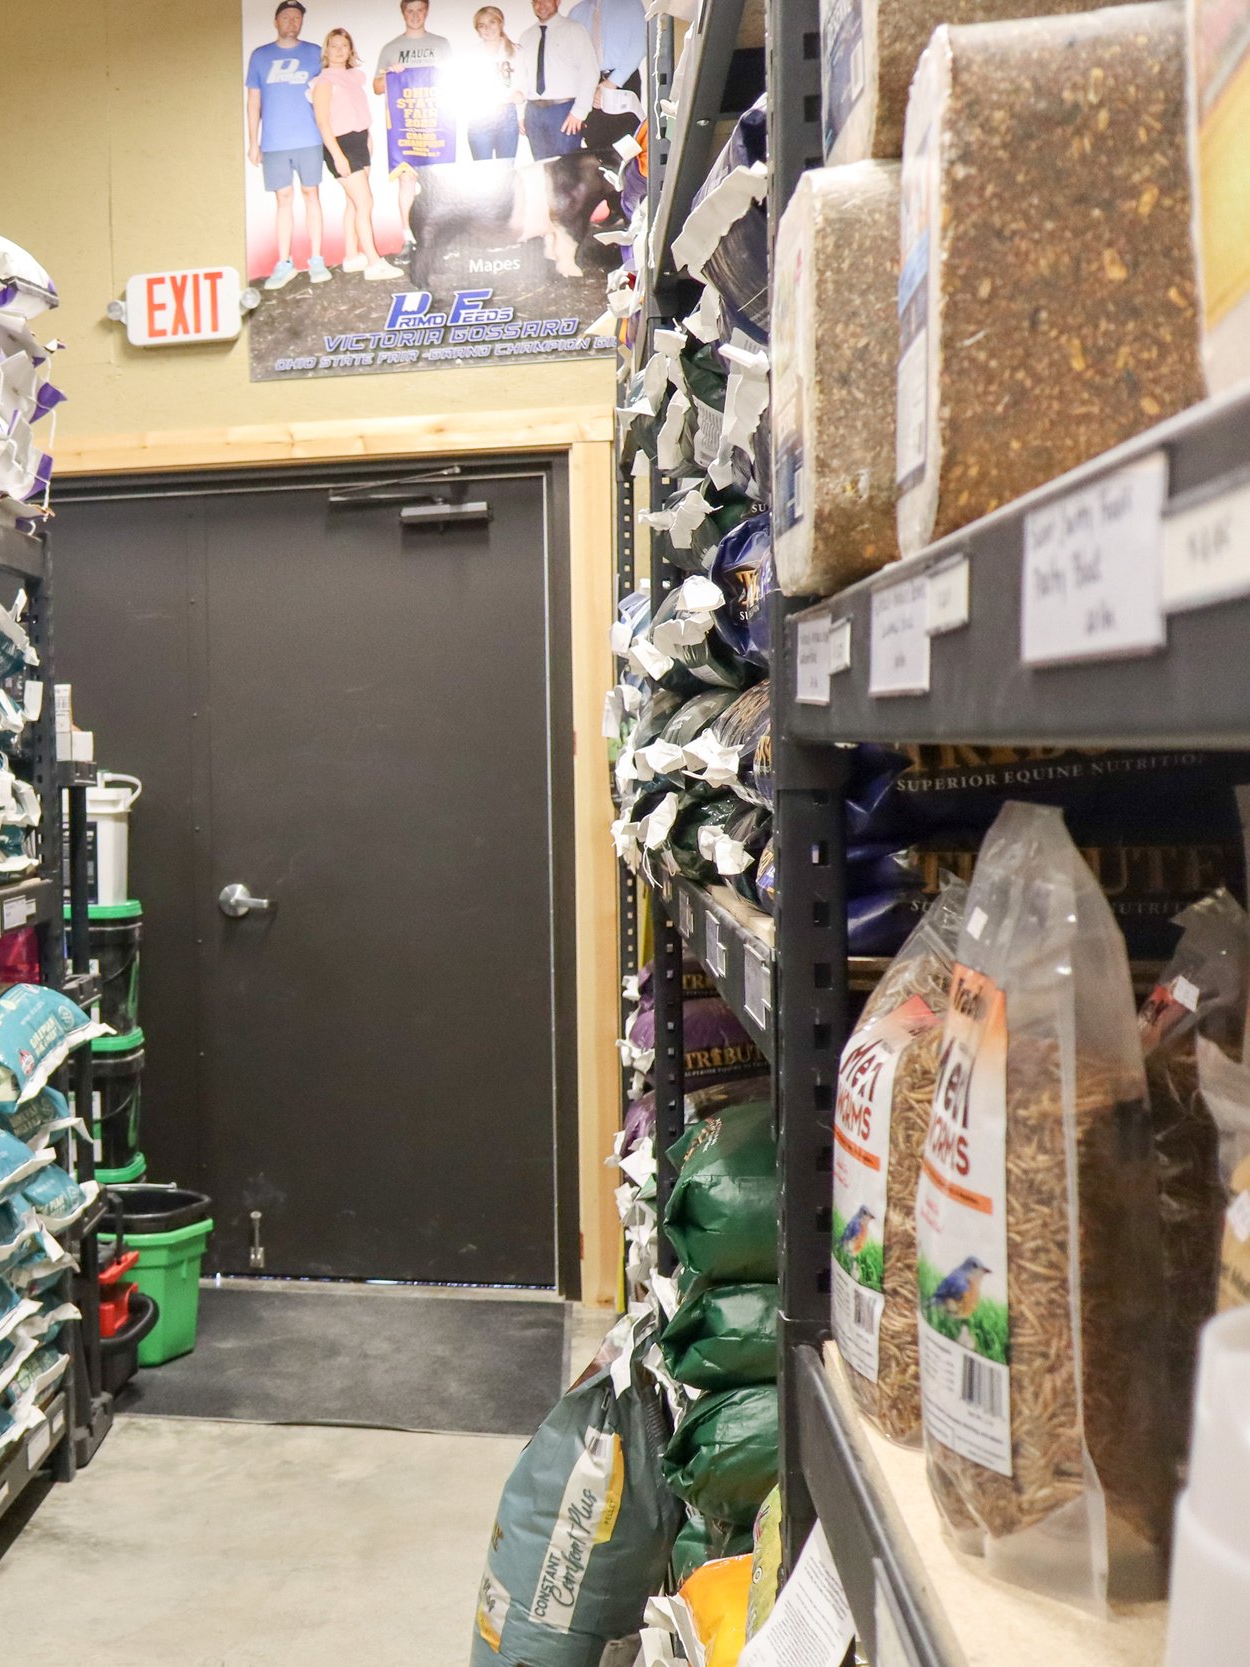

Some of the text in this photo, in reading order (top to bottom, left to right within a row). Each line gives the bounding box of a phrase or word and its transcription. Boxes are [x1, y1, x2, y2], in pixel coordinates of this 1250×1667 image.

[468, 257, 521, 275] Mapes
[145, 271, 225, 338] EXIT
[384, 288, 515, 330] PRIMO FEEDS
[275, 356, 316, 371] OHIO
[318, 351, 373, 369] STATE
[377, 350, 418, 364] FAIR
[493, 336, 590, 357] CHAMPION
[323, 318, 580, 352] VICTORIA GOSSARD
[896, 772, 997, 793] SUPERIOR
[1004, 765, 1083, 785] EQUINE
[568, 1488, 598, 1535] Plus
[604, 1500, 617, 1525] PELLET
[534, 1552, 561, 1617] CONSTANT
[550, 1525, 587, 1608] Comfort
